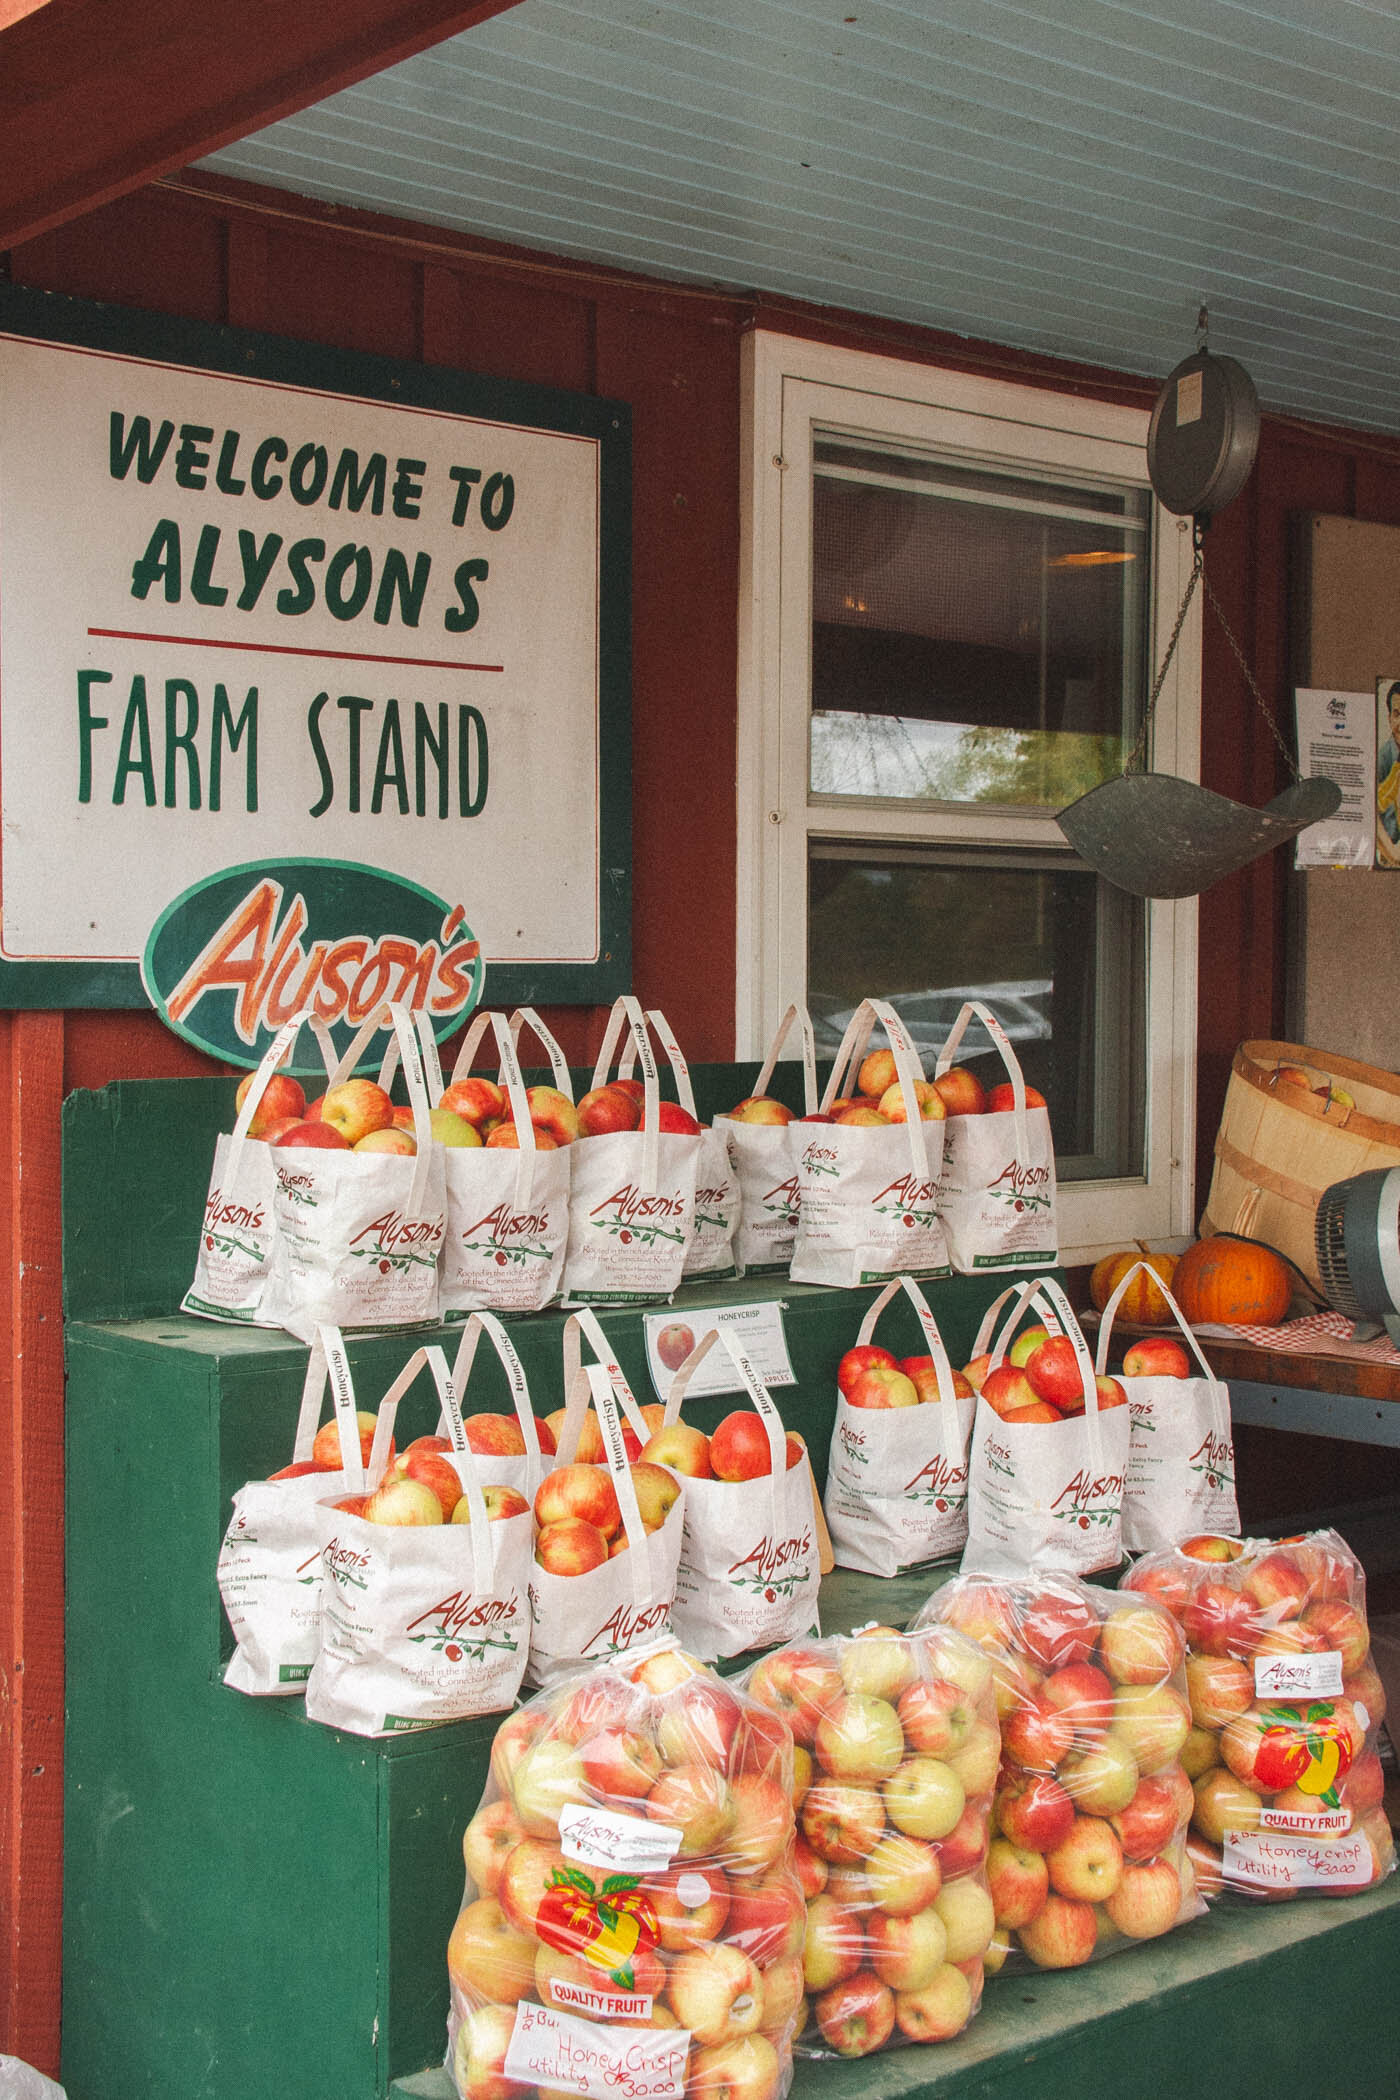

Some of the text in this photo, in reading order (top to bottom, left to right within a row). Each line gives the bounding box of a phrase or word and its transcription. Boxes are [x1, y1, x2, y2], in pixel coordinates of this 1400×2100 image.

[110, 411, 516, 531] WELCOME TO
[77, 669, 489, 820] FARM STAND
[167, 878, 480, 1047] Alyson's
[533, 1023, 562, 1067] Honeycrisp
[635, 1023, 655, 1079] Honeycrisp
[206, 1188, 266, 1233] Alyson's
[462, 1202, 549, 1247] Alyson's
[589, 1184, 686, 1226] Alyson's
[350, 1210, 445, 1256] Alyson's
[718, 1310, 760, 1321] HONEYCRISP
[1058, 1296, 1086, 1352] Honeycrisp
[331, 1350, 350, 1408] Honeycrisp
[500, 1334, 524, 1392] Honeycrisp
[764, 1375, 789, 1383] APPLES
[740, 1357, 772, 1415] Honeycrisp
[444, 1381, 466, 1451] Honeycrisp
[603, 1399, 625, 1472] Honeycrisp
[322, 1537, 372, 1567] Alyson's
[728, 1524, 811, 1582] Alyson's
[406, 1587, 518, 1638] Alyson's
[723, 1606, 754, 1616] Rooted
[421, 1677, 434, 1686] the
[446, 1667, 460, 1676] the
[1261, 1662, 1312, 1684] Alyson's
[1264, 1813, 1347, 1829] QUALITY FRUIT
[1237, 1858, 1297, 1882] Utility
[1258, 1841, 1361, 1867] Honey crisp
[554, 1984, 648, 2015] QUALITY FRUIT
[528, 2057, 590, 2092] utility
[558, 2032, 684, 2083] Honey Crisp
